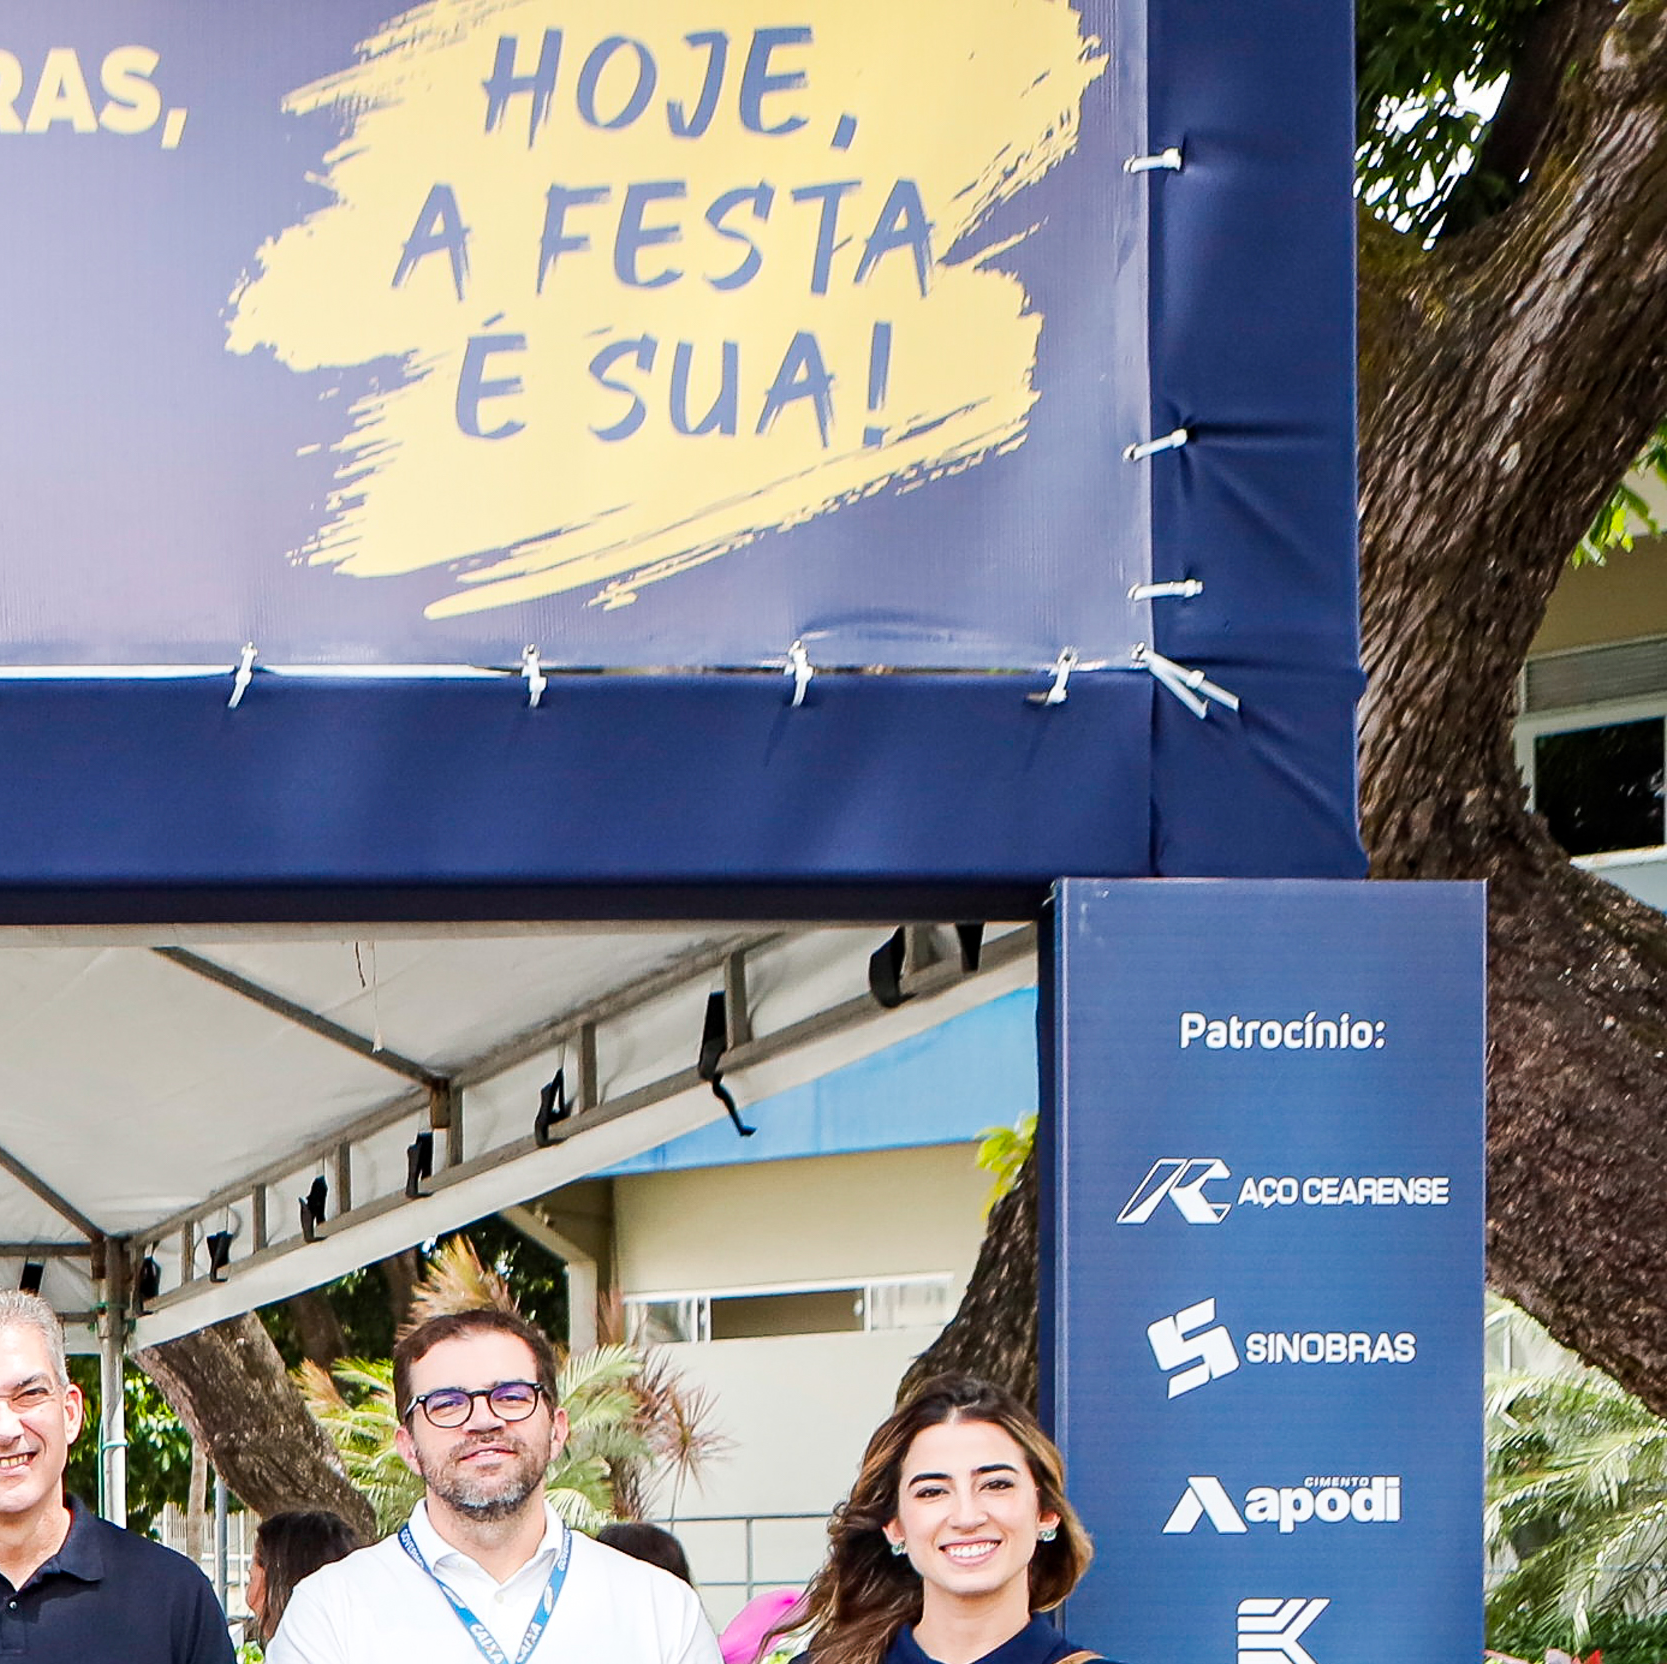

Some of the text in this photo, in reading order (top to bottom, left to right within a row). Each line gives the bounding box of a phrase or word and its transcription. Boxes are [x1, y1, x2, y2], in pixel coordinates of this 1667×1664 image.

[479, 25, 857, 152] HOJE,
[392, 178, 934, 302] A FESTA
[451, 314, 894, 447] É SUA!
[1179, 1010, 1387, 1050] Patrocínio:
[1237, 1176, 1450, 1209] AÇO CEARENSE
[1244, 1332, 1417, 1365] SINOBRAS
[1303, 1477, 1370, 1488] CIMENTO
[1243, 1476, 1402, 1533] apodi
[517, 1621, 543, 1663] CAIXA
